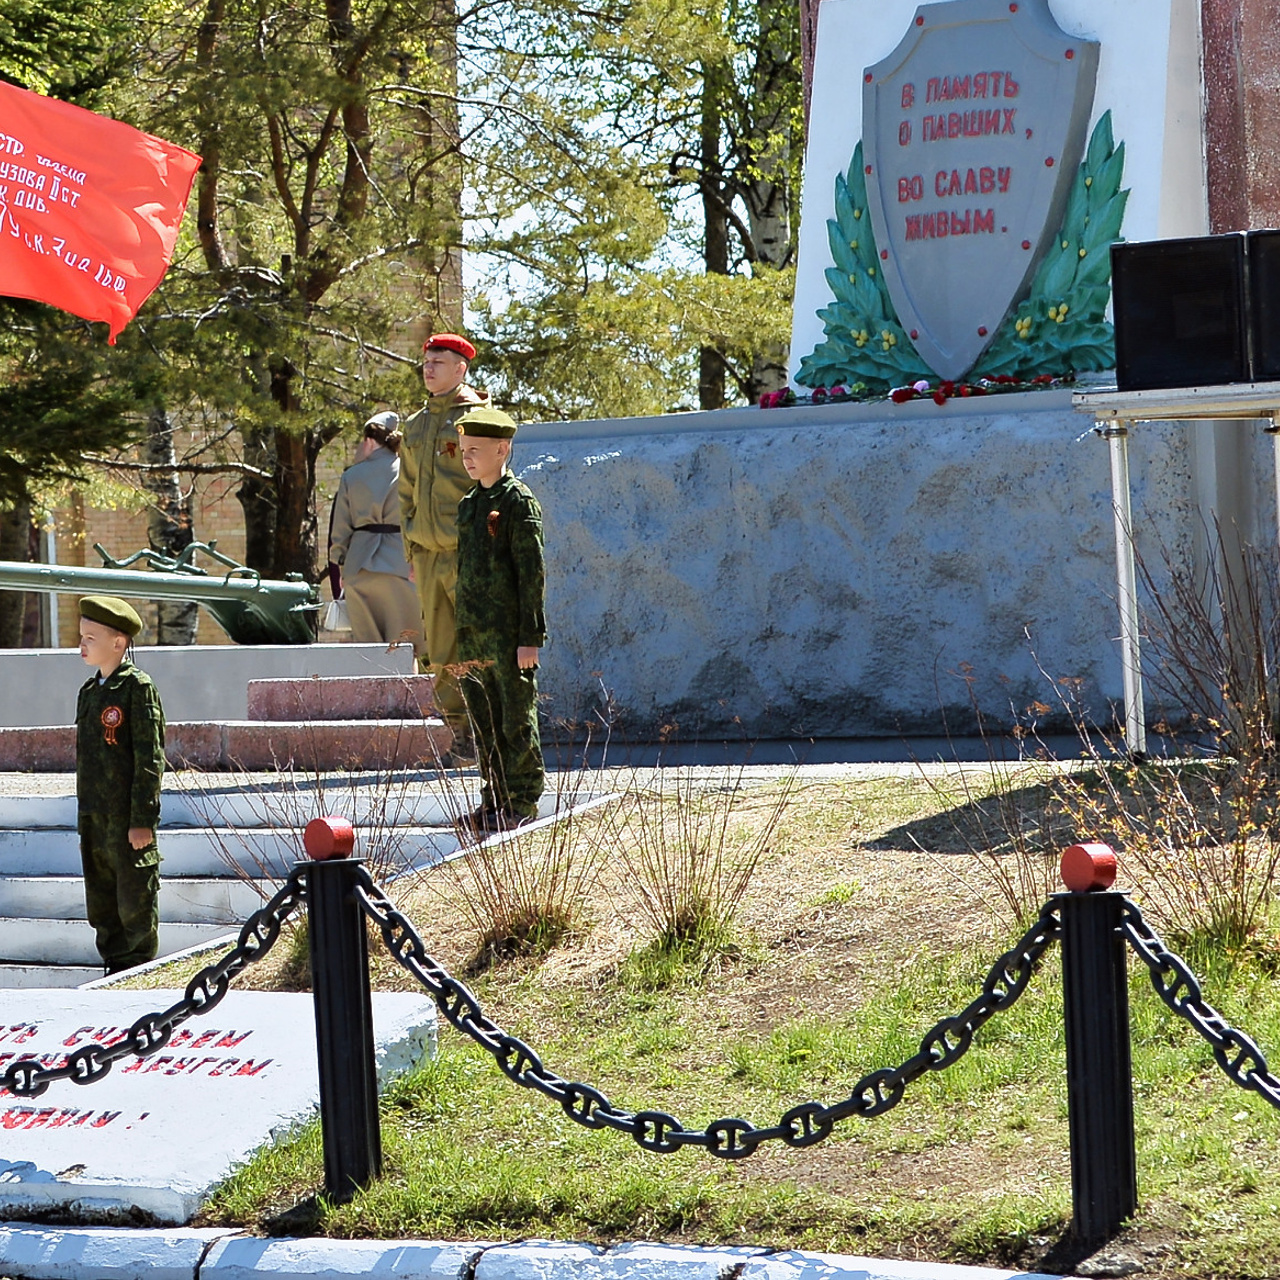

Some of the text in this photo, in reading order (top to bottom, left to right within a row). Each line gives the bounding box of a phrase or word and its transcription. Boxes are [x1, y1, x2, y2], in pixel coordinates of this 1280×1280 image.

[901, 72, 1019, 109] В ПАМЯТЬ
[898, 120, 912, 146] О
[897, 166, 1011, 203] ВО СЛАВУ
